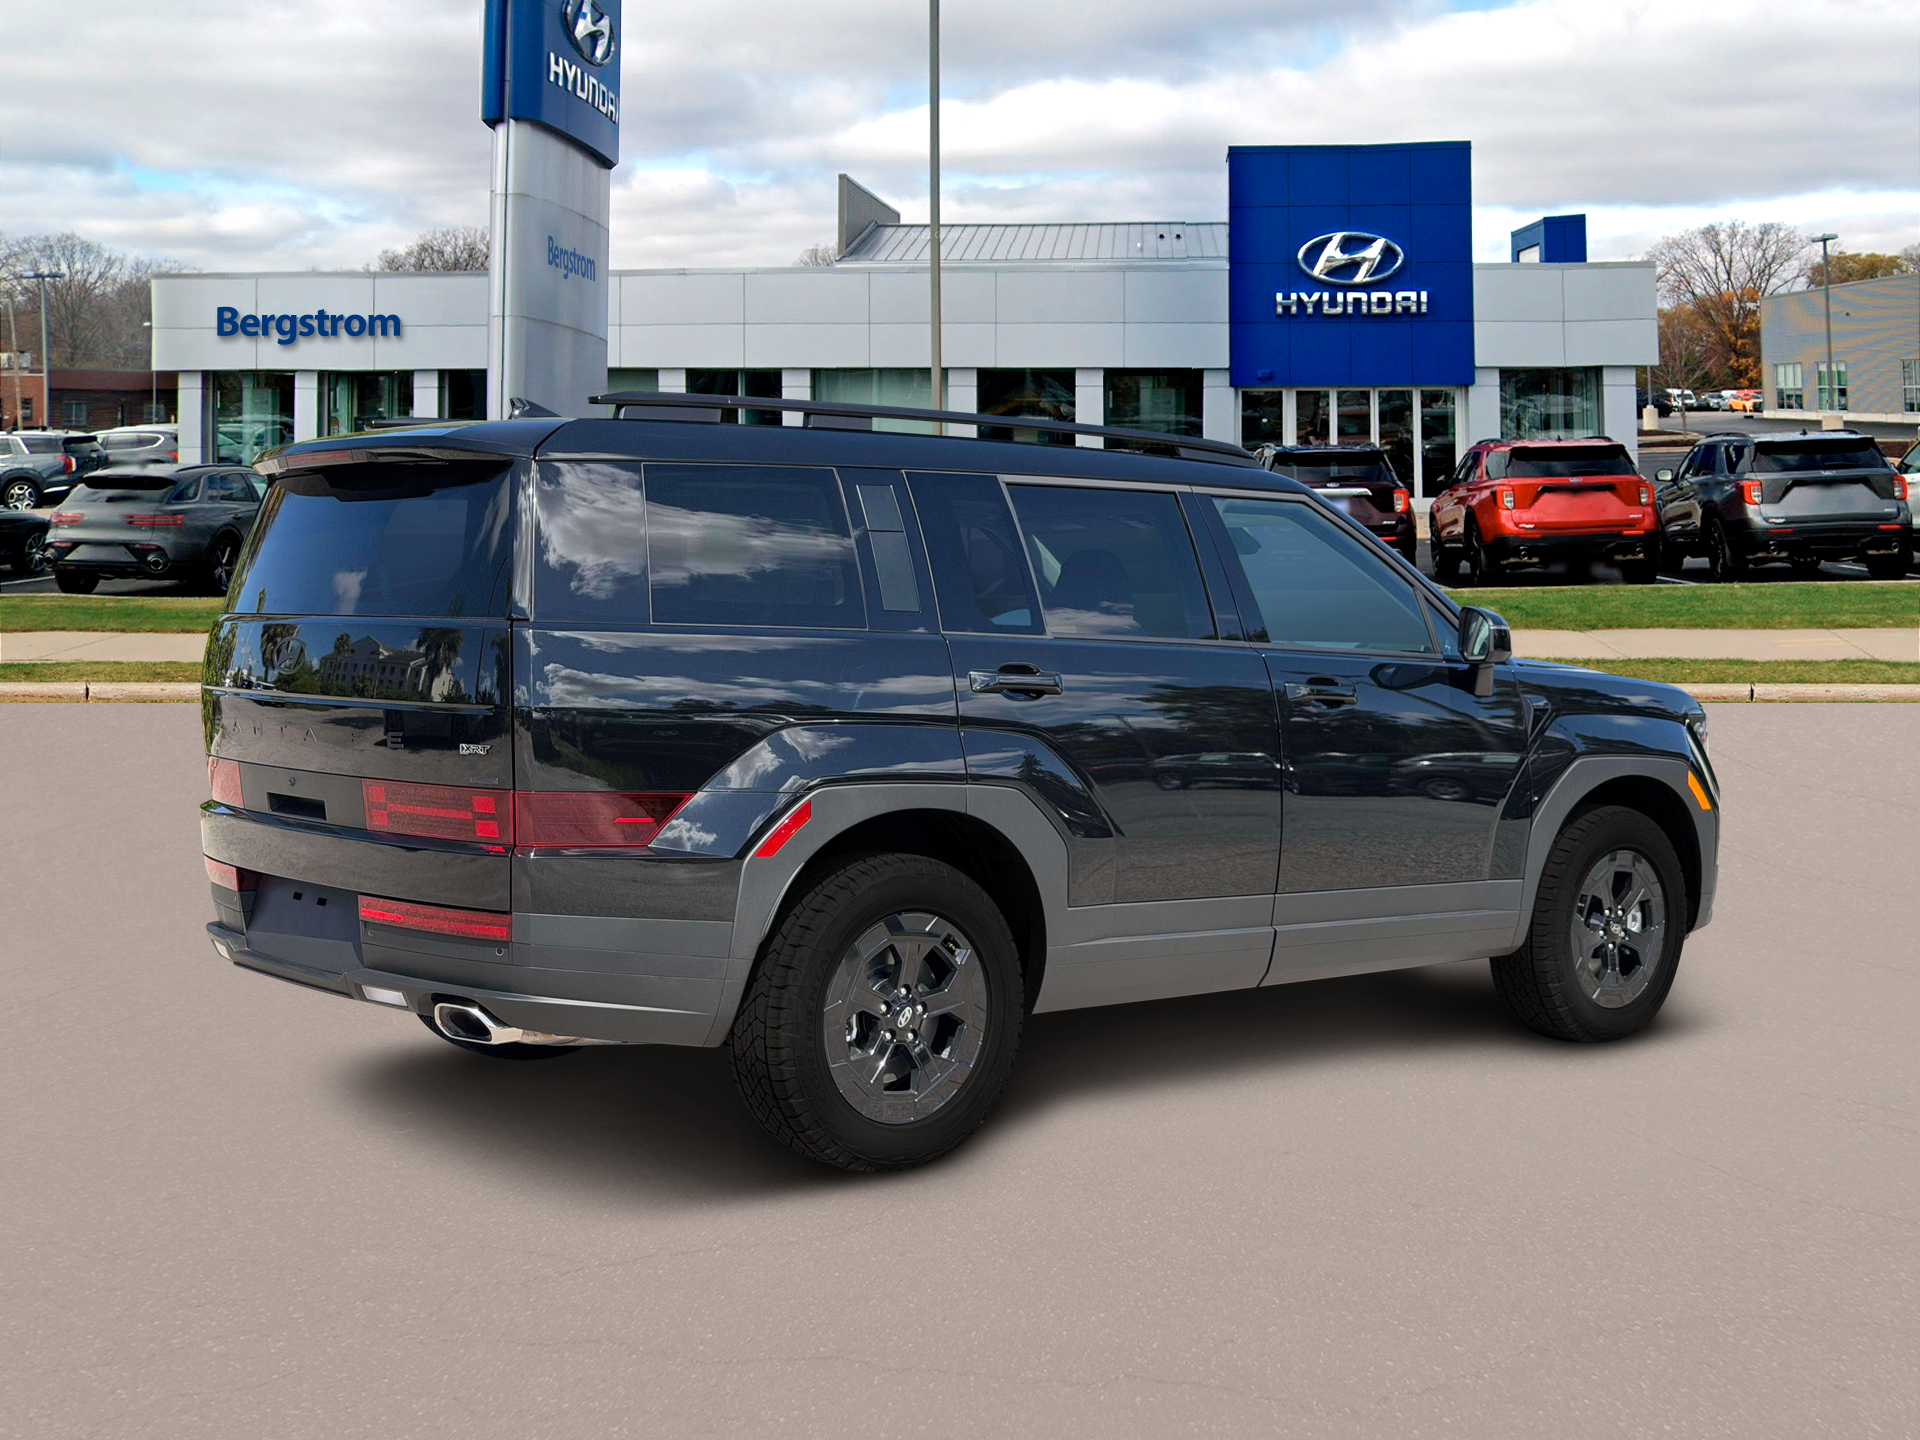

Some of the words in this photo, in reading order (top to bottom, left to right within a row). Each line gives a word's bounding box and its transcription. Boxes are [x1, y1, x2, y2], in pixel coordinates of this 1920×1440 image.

[548, 51, 619, 124] HYUNDAI
[547, 235, 597, 281] Bergstrom
[1275, 290, 1428, 316] HYUNDAI
[216, 306, 402, 345] Bergstrom
[459, 743, 491, 756] XRT
